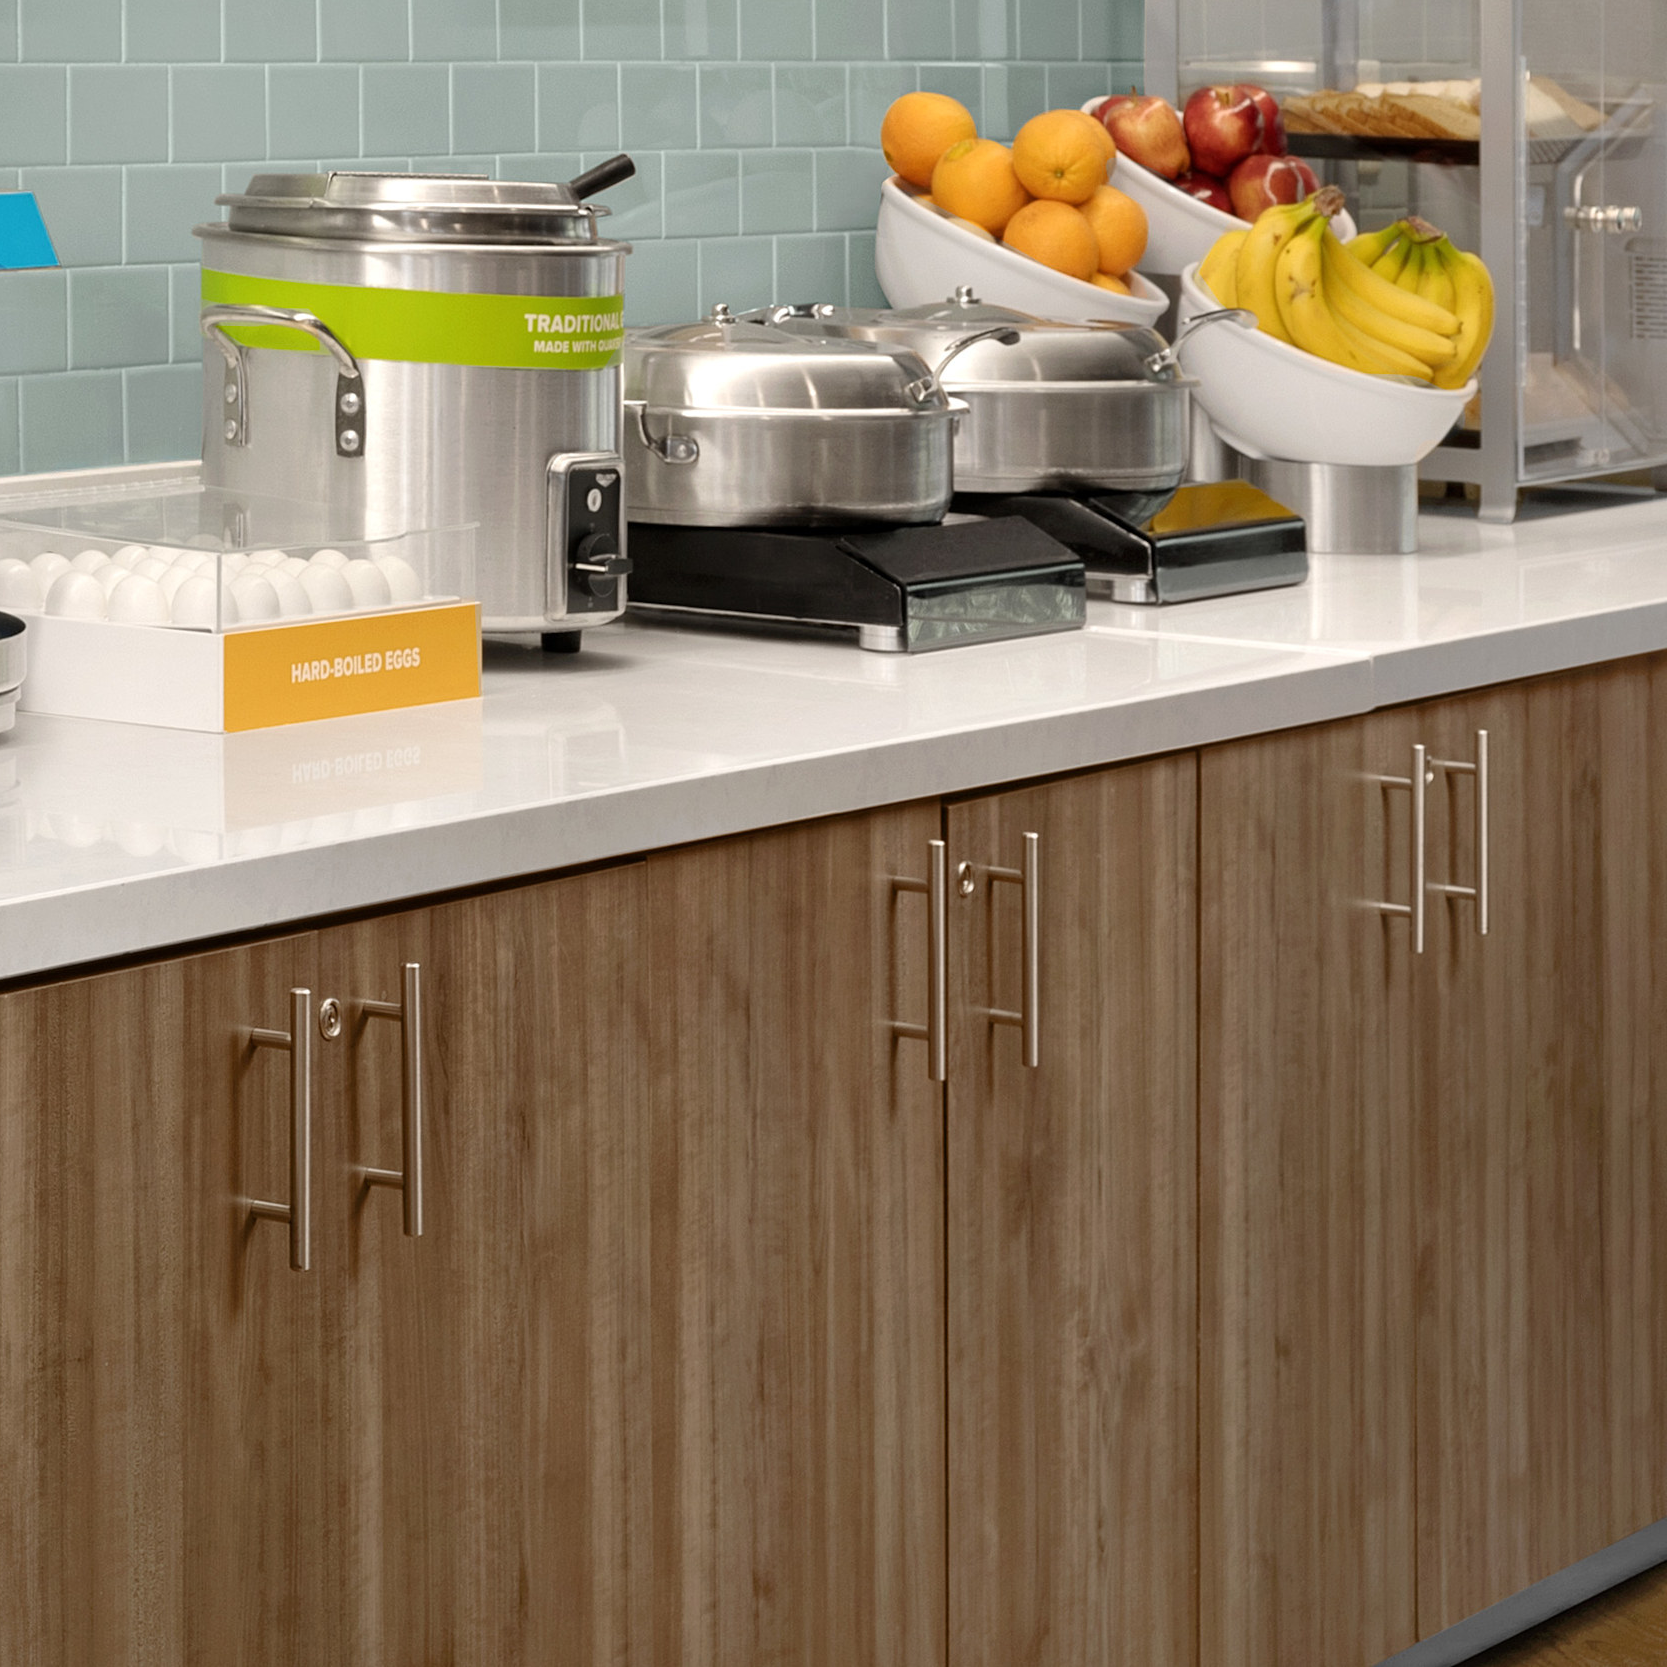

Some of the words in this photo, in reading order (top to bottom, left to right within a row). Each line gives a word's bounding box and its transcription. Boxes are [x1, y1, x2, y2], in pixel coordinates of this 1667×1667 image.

[524, 312, 619, 333] TRADITIONAL
[533, 340, 569, 353] MADE
[572, 340, 597, 353] WITH
[291, 653, 382, 683] HARD-BOILED
[385, 647, 421, 670] EGGS
